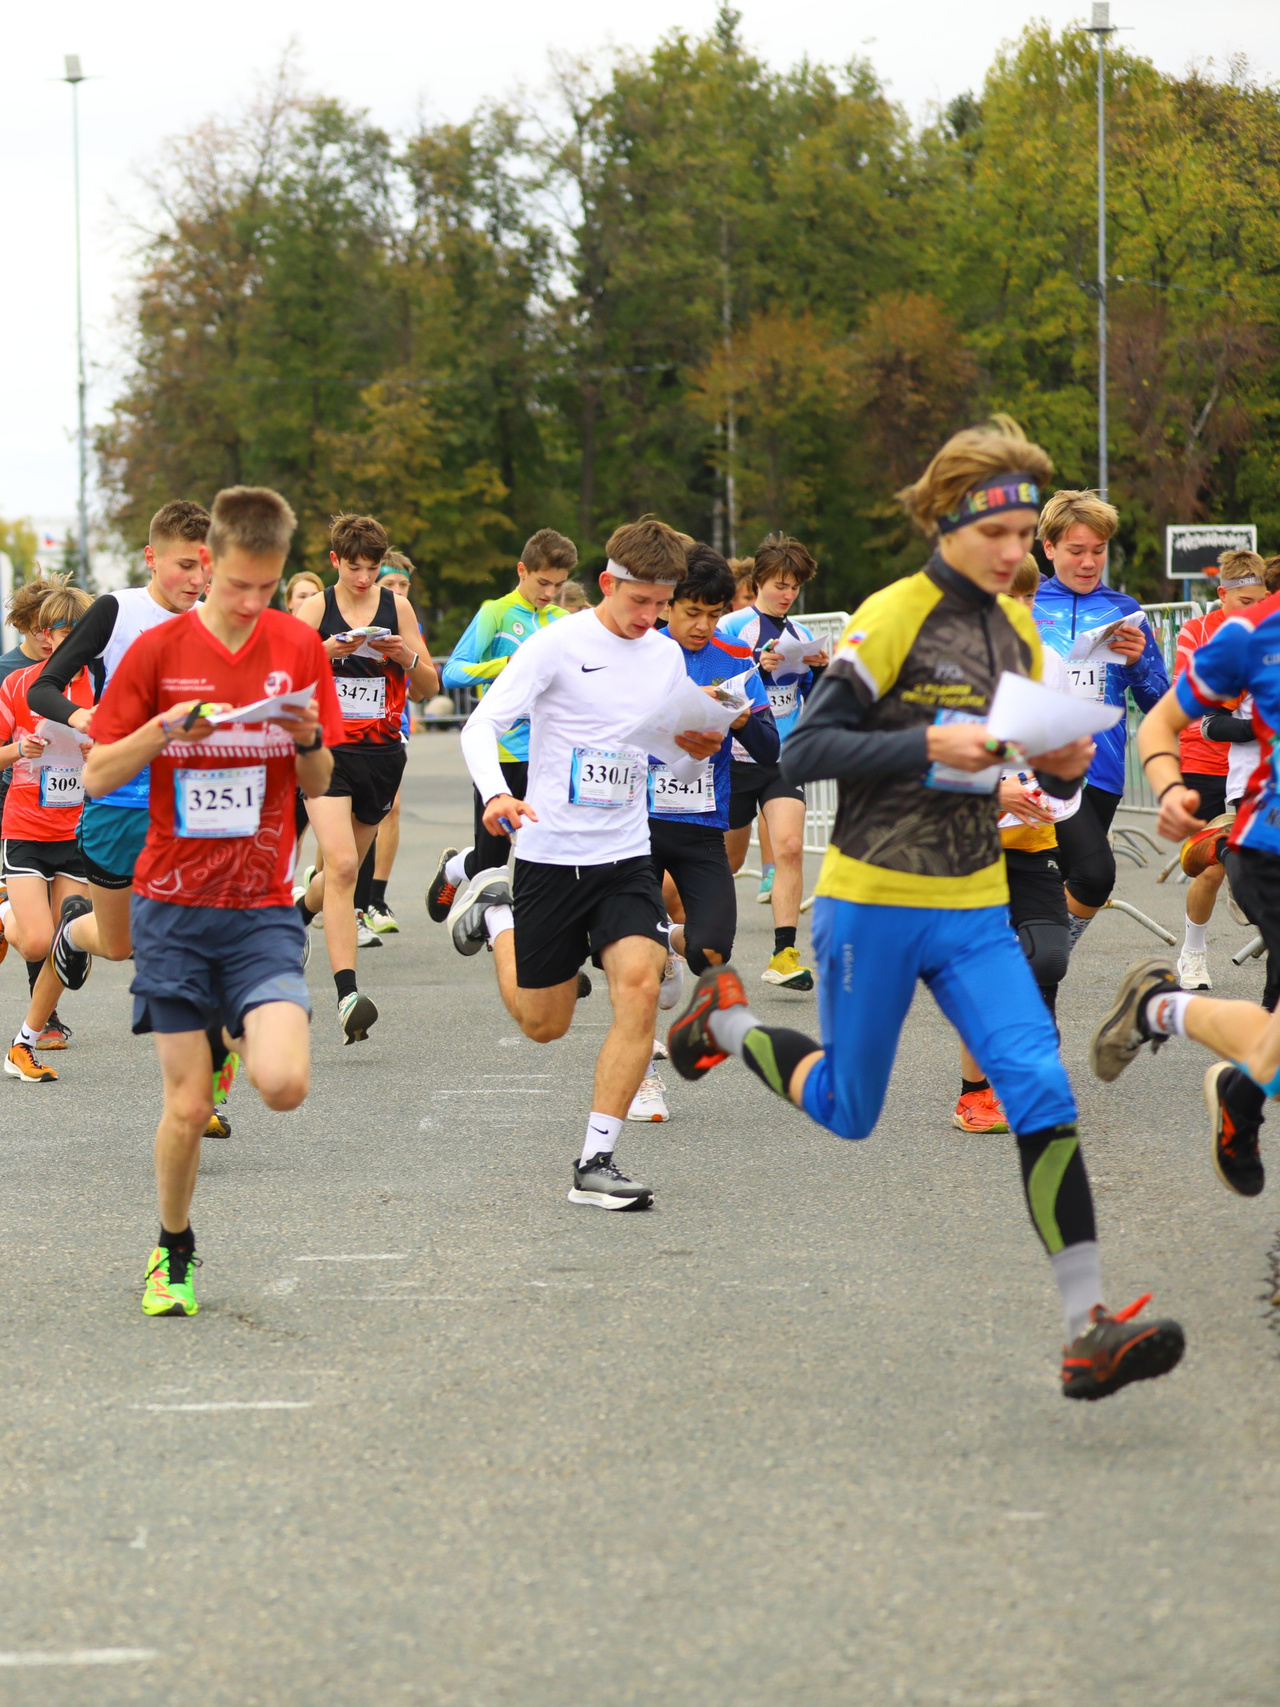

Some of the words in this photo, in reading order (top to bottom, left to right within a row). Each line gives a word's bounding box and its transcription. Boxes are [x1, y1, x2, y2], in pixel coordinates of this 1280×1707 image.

[1066, 669, 1096, 686] 7.1
[337, 683, 379, 703] 347.1
[47, 777, 84, 792] 309.
[581, 764, 630, 786] 330.1
[655, 777, 703, 795] 354.1
[188, 786, 253, 812] 325.1
